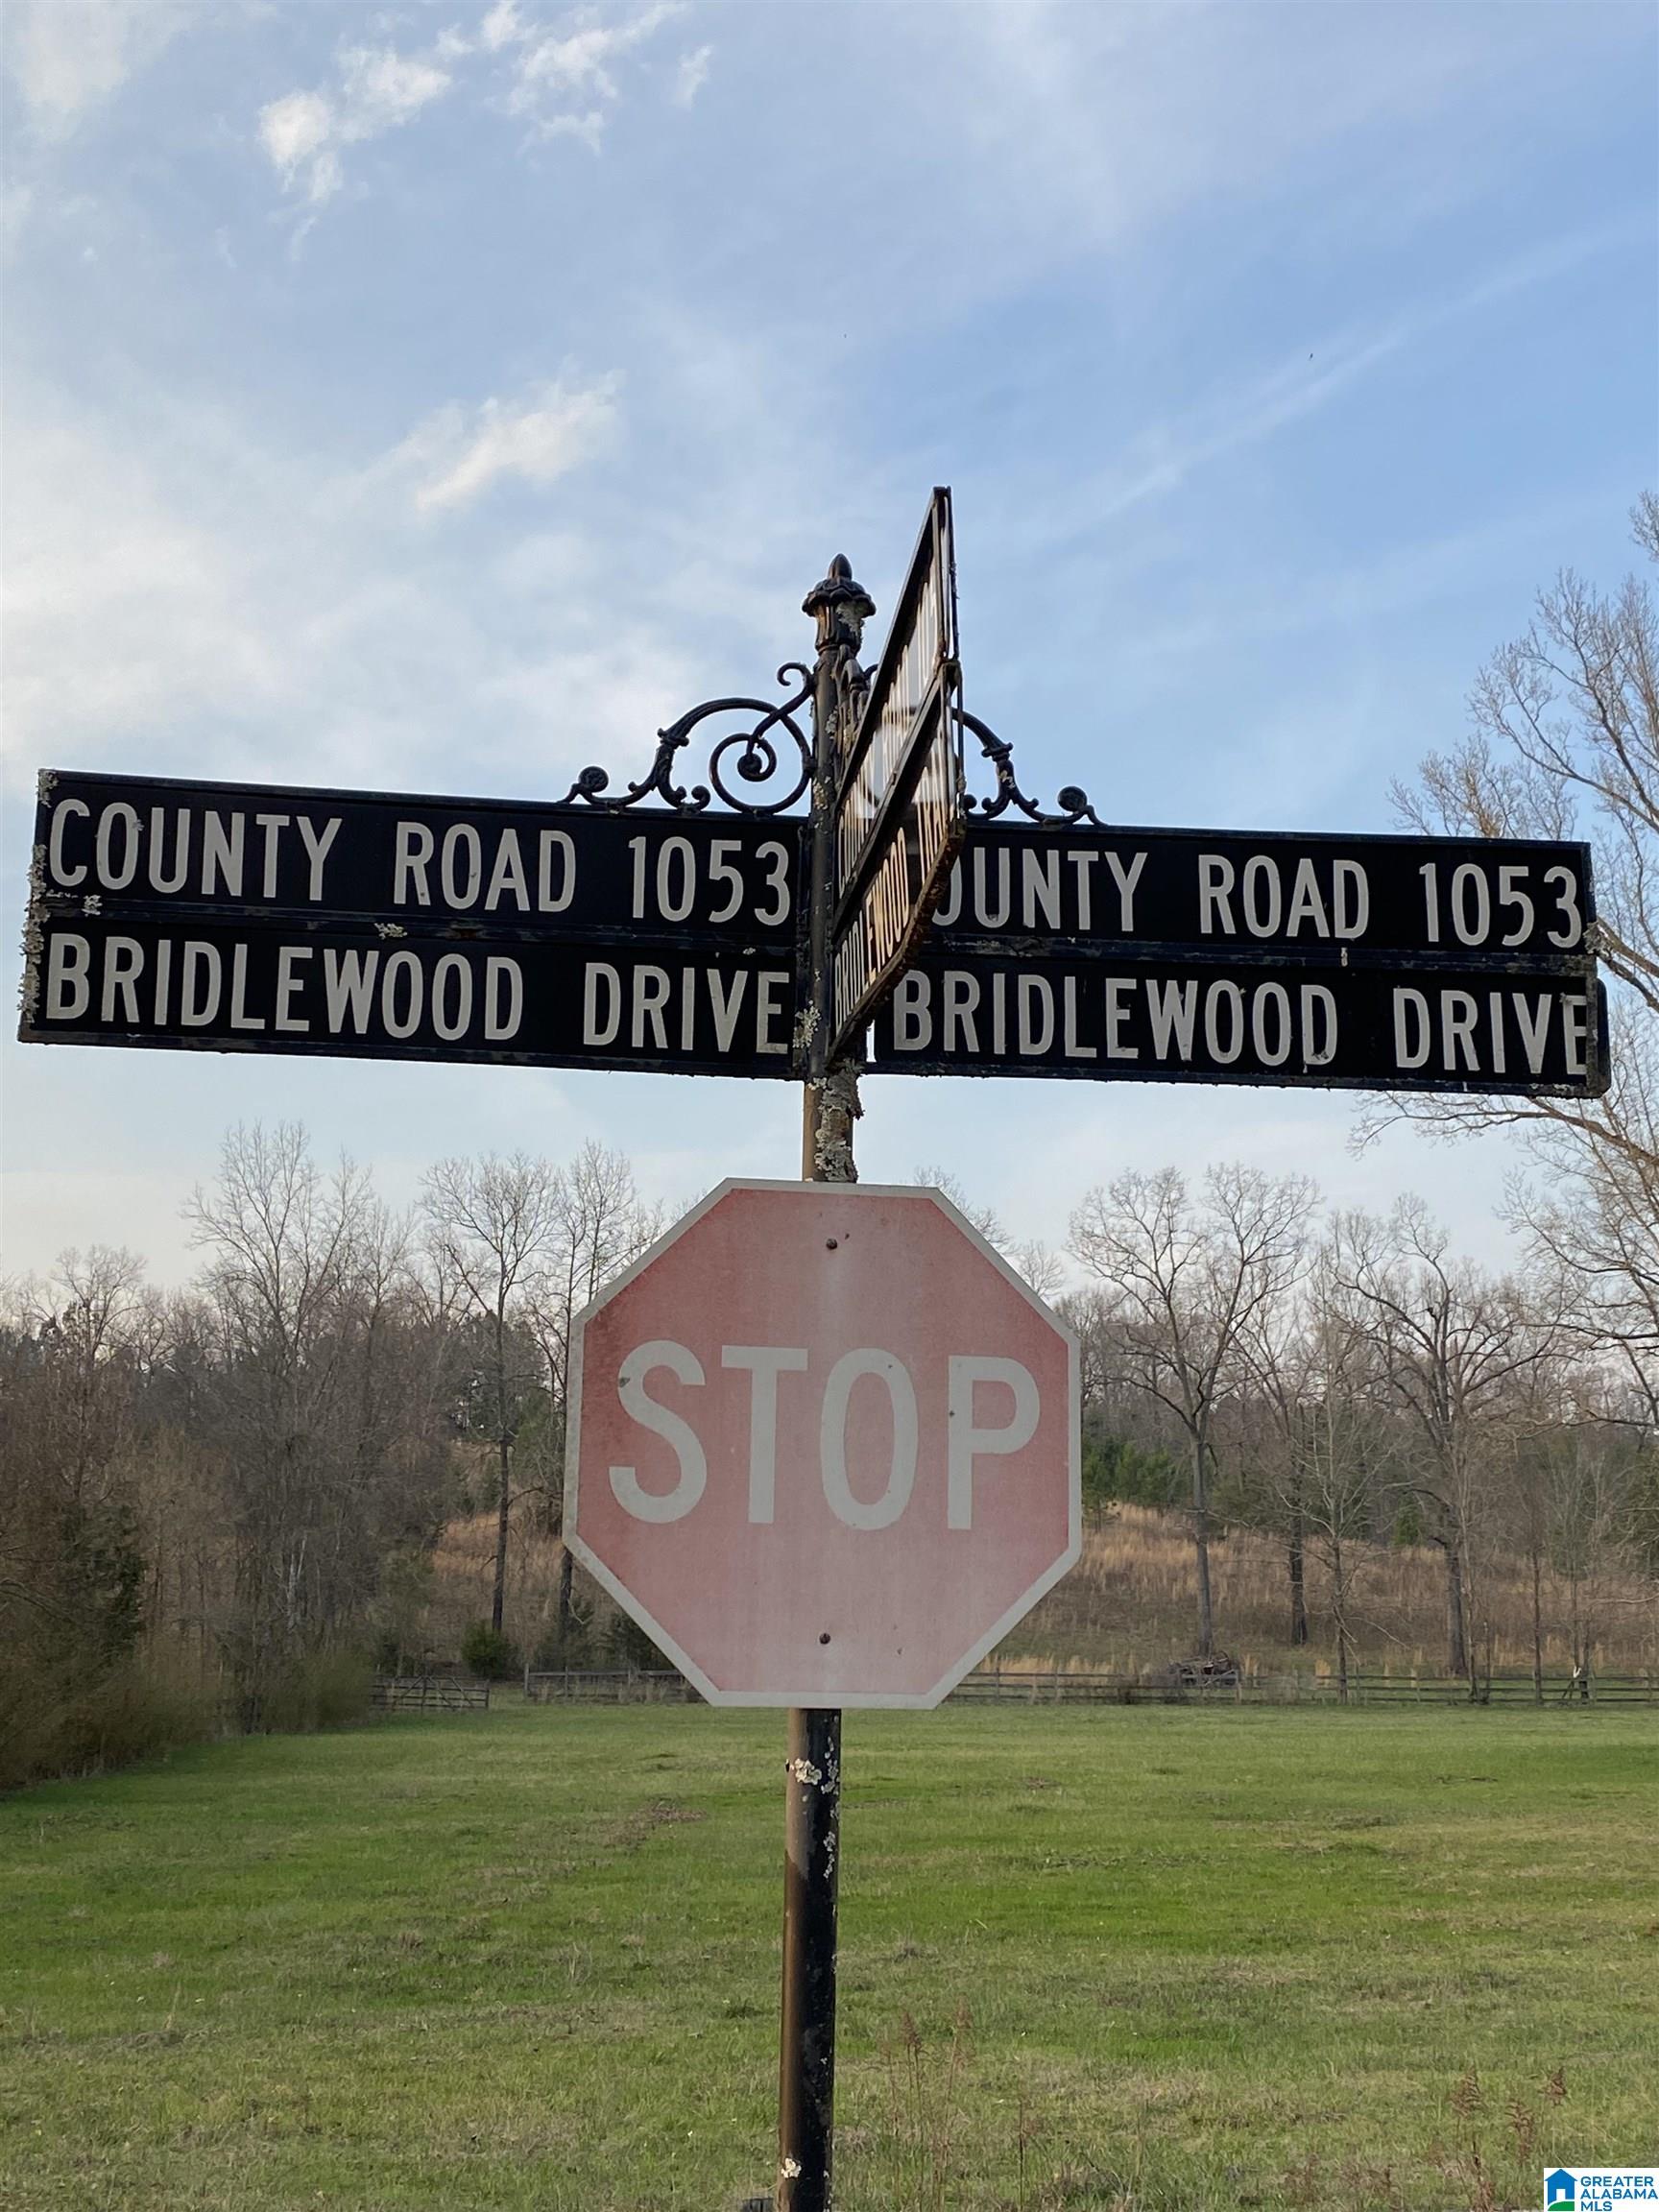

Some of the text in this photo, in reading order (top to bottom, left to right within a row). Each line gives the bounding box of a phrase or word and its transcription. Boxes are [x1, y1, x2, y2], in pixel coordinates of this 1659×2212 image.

[49, 798, 791, 926] COUNTY ROAD 1053
[1198, 854, 1369, 940] ROAD
[1419, 862, 1582, 949] 1053
[46, 932, 790, 1054] BRIDLEWOOD DRIVE
[834, 826, 910, 1038] BRIDLEWOOD
[893, 969, 1588, 1075] BRIDLEWOOD DRIVE
[609, 1340, 1040, 1531] STOP
